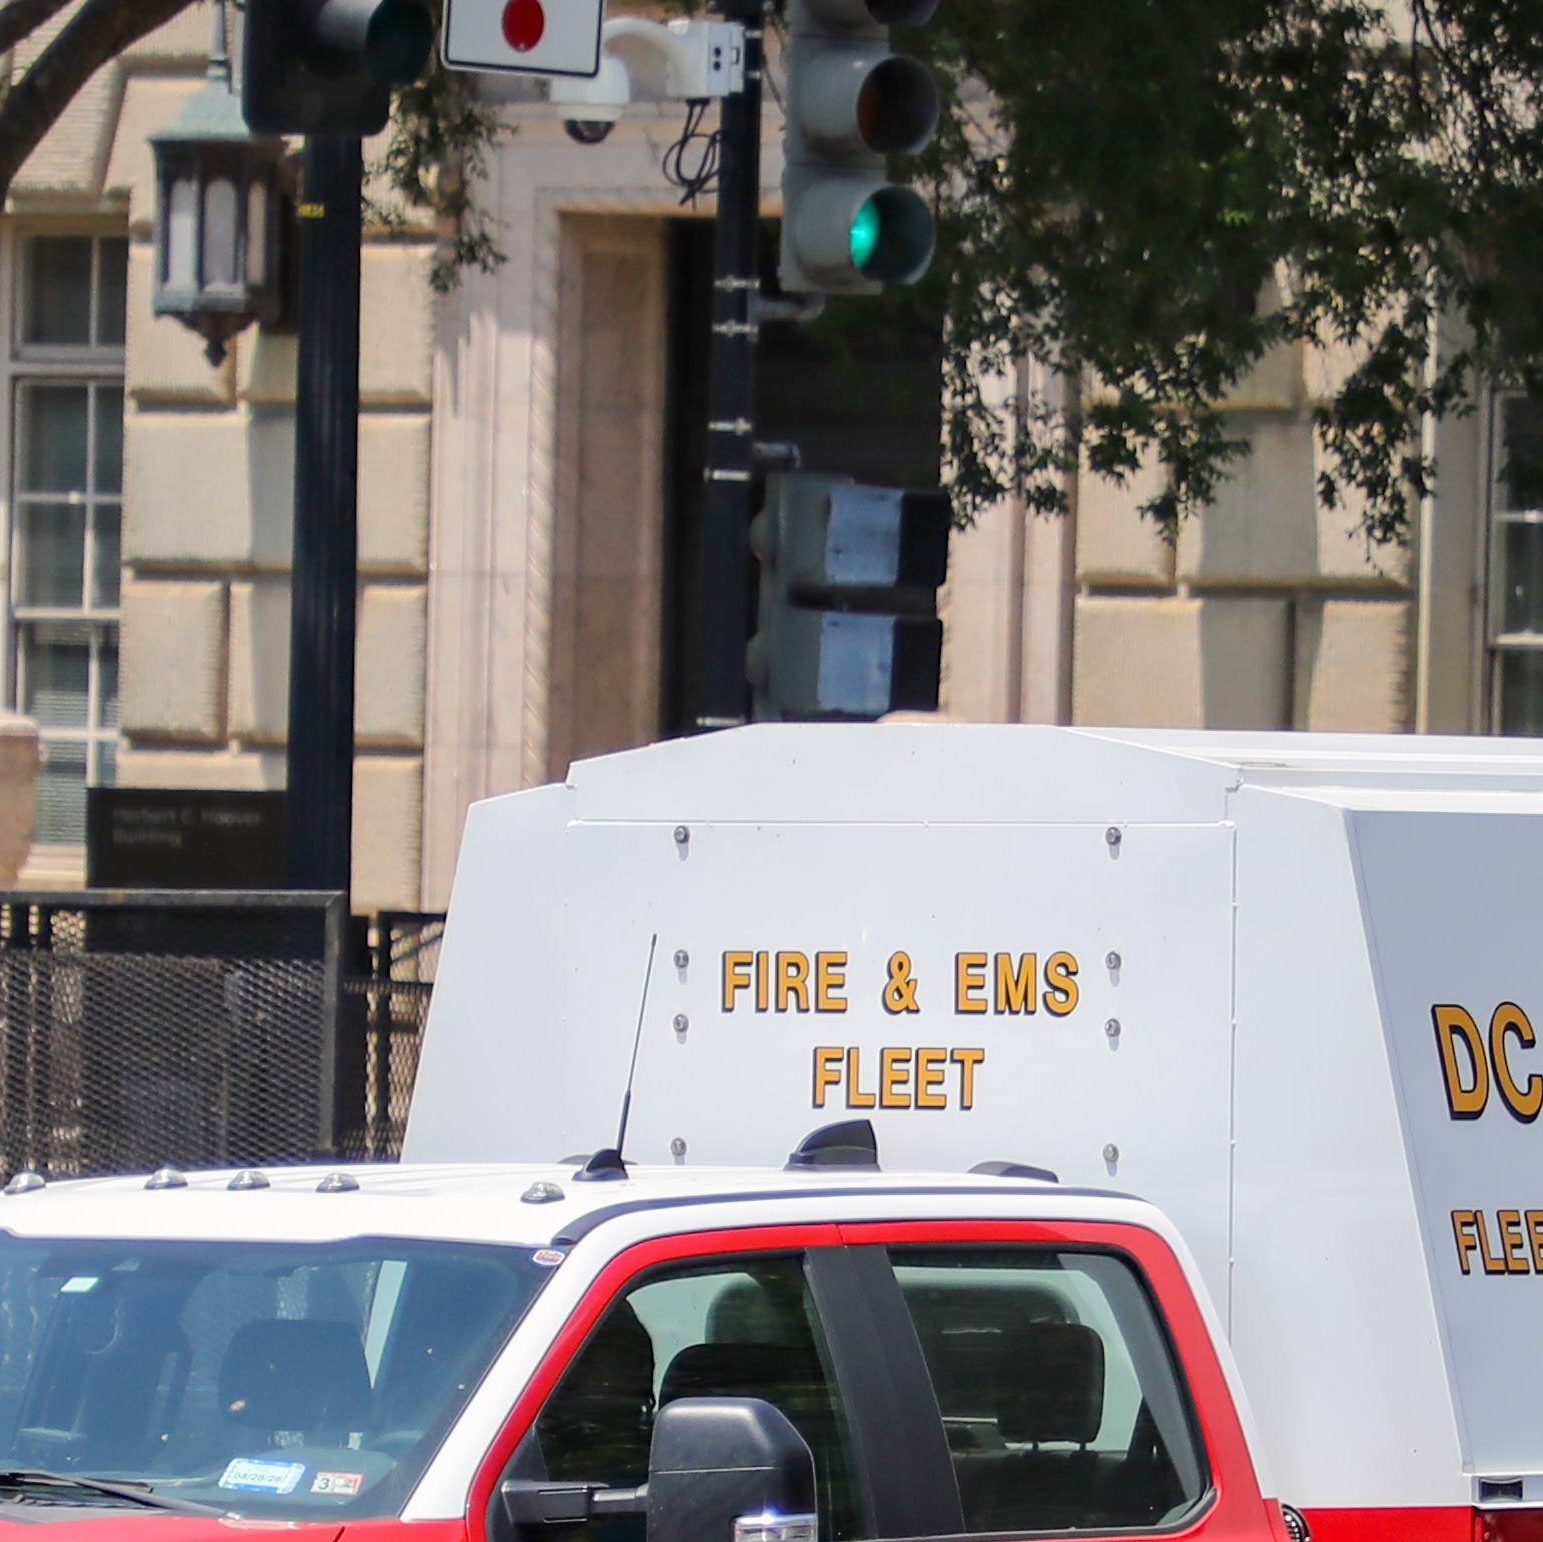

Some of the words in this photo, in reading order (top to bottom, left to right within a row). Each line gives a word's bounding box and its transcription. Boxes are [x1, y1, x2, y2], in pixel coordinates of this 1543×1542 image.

[722, 951, 847, 1013] FIRE
[883, 951, 920, 1013] &
[955, 951, 1079, 1016] EMS
[812, 1046, 984, 1110] FLEET
[1431, 1002, 1543, 1123] DC
